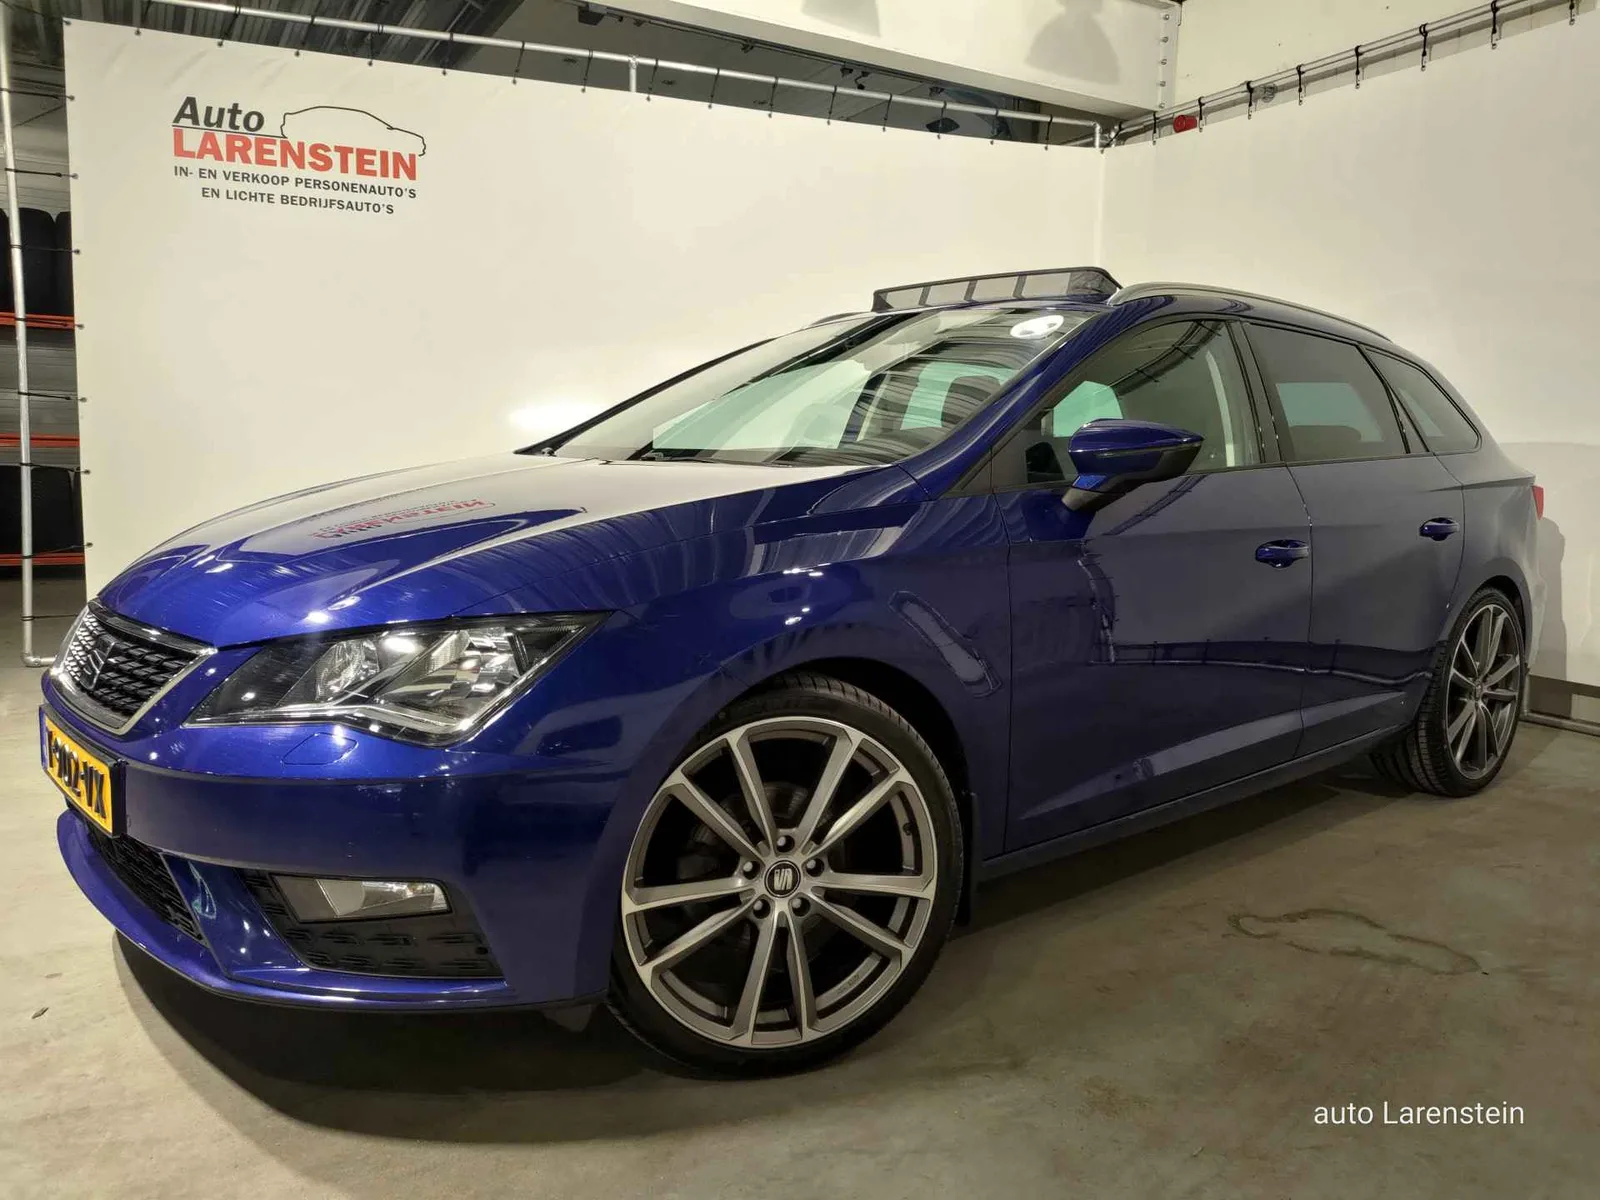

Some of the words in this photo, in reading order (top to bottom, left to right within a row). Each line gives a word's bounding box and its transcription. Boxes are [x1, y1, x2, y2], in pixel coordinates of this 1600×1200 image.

[172, 96, 265, 132] Auto
[173, 128, 417, 181] LARENSTEIN
[174, 166, 194, 177] IN-
[199, 168, 218, 180] EN
[223, 171, 290, 187] VERKOOP
[294, 178, 417, 199] PERSONENAUTO'S
[201, 187, 221, 199] EN
[226, 189, 276, 204] LICHTE
[280, 194, 395, 214] BEDRIJFSAUTO'S
